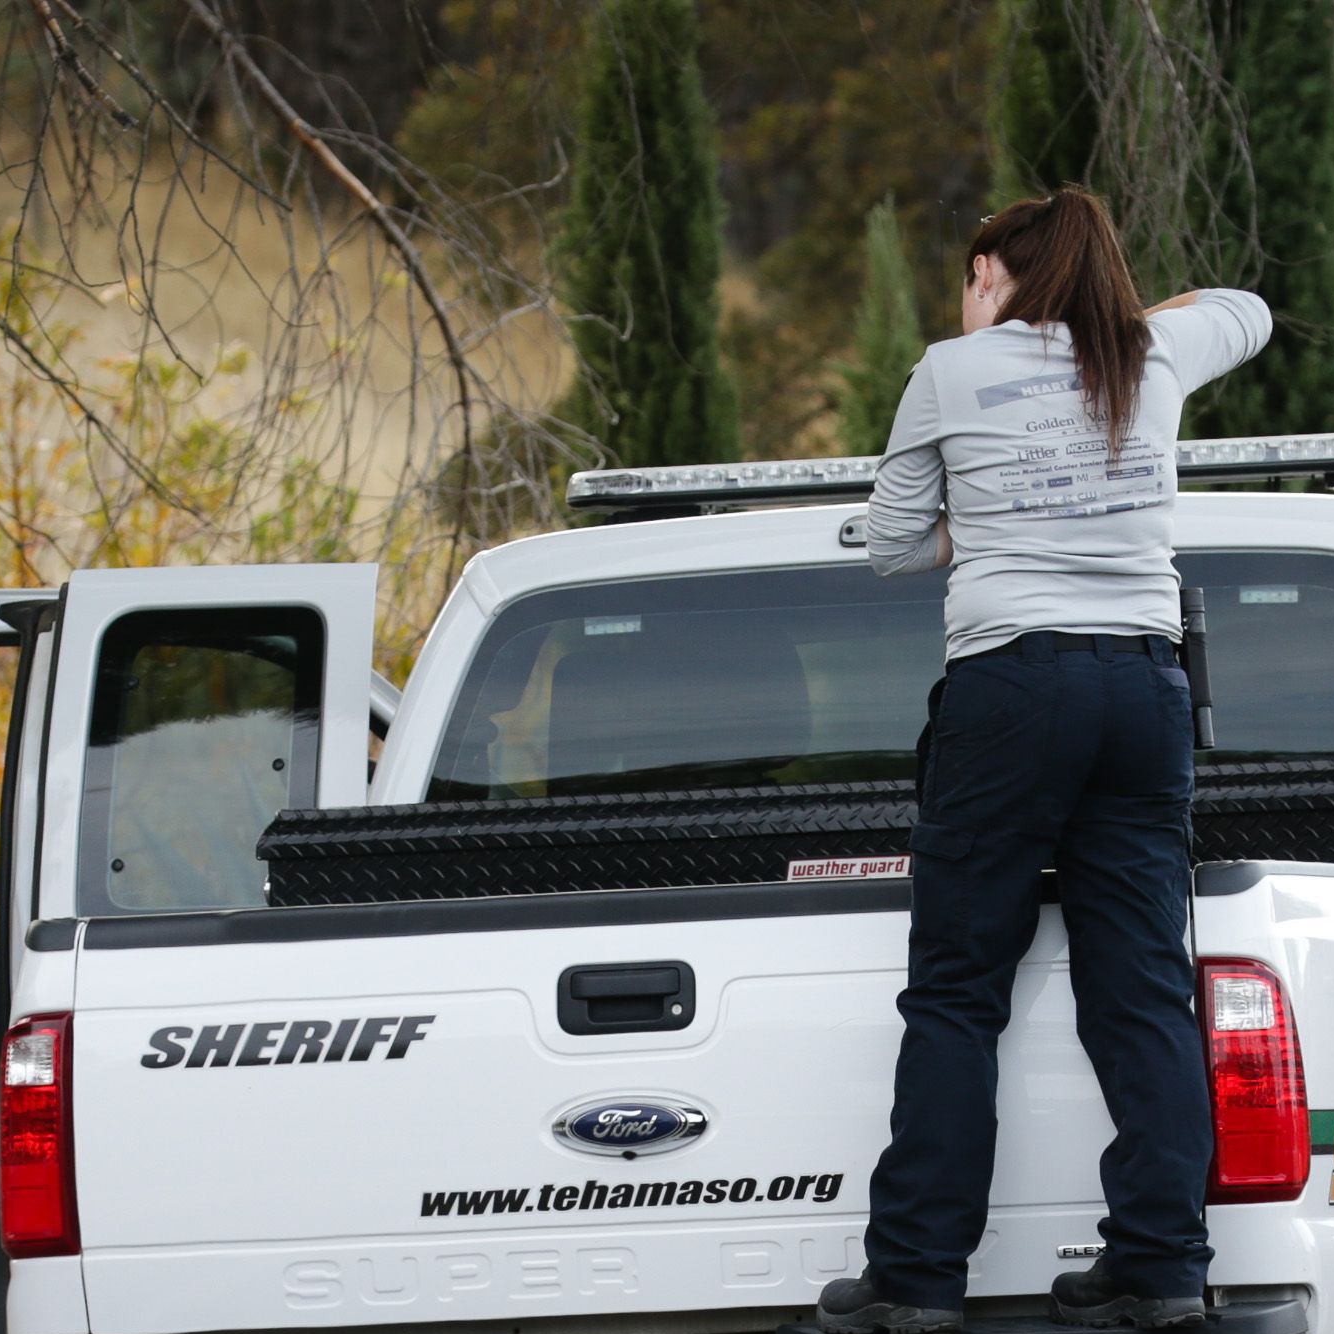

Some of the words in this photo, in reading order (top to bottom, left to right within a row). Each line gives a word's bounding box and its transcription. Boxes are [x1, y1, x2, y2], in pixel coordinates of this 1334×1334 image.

[1020, 380, 1069, 397] HEART
[1026, 416, 1075, 433] Golden
[1017, 447, 1059, 462] Littler
[1067, 439, 1107, 454] MODERN
[1022, 466, 1052, 474] Medical
[1054, 463, 1078, 471] Center
[793, 861, 856, 876] weather
[860, 859, 905, 877] guard
[140, 1014, 436, 1069] SHERIFF
[593, 1109, 658, 1138] Ford
[420, 1172, 845, 1218] www.tehamaso.org
[1063, 1246, 1107, 1257] FLEX
[282, 1246, 640, 1309] SUPER
